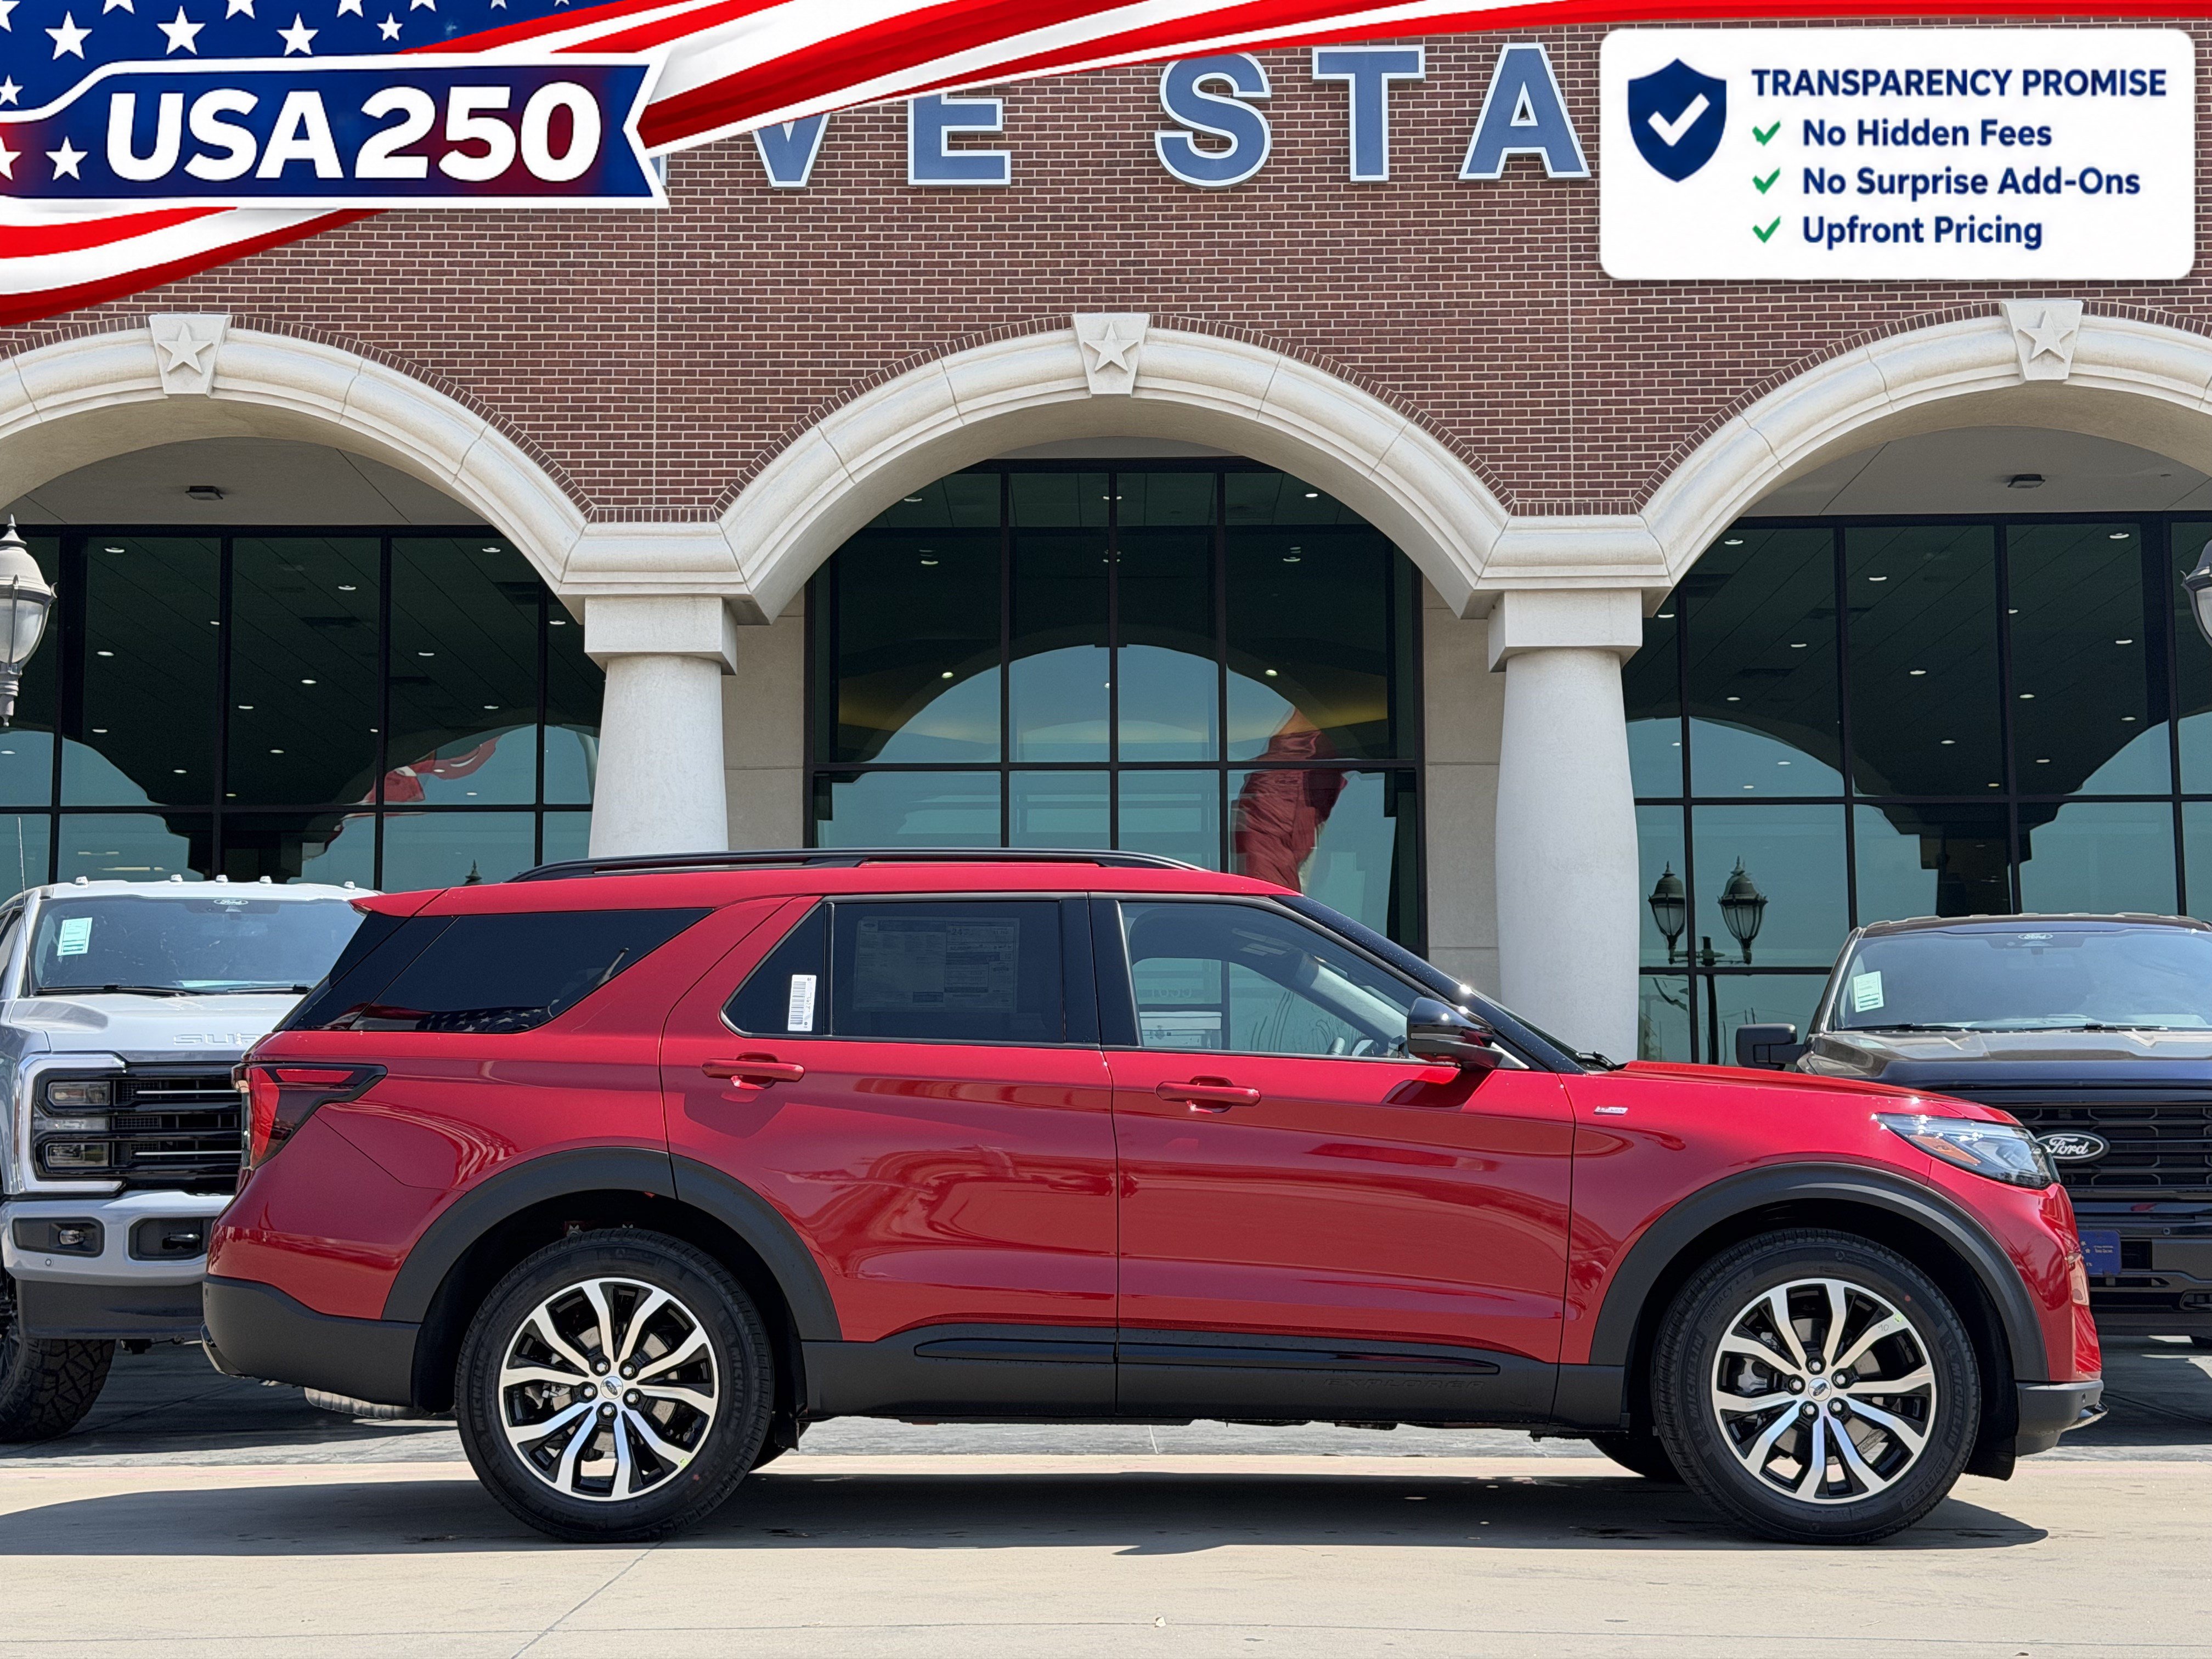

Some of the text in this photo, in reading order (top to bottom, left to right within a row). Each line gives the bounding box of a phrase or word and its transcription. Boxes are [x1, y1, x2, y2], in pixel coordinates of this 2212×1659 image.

[2049, 1137, 2089, 1155] Ford
[1703, 1286, 1733, 1324] PRIMACY
[1323, 1378, 1485, 1389] EXPLORER
[1686, 1334, 1704, 1419] MICHELIN
[1948, 1362, 1964, 1447] MICHELIN
